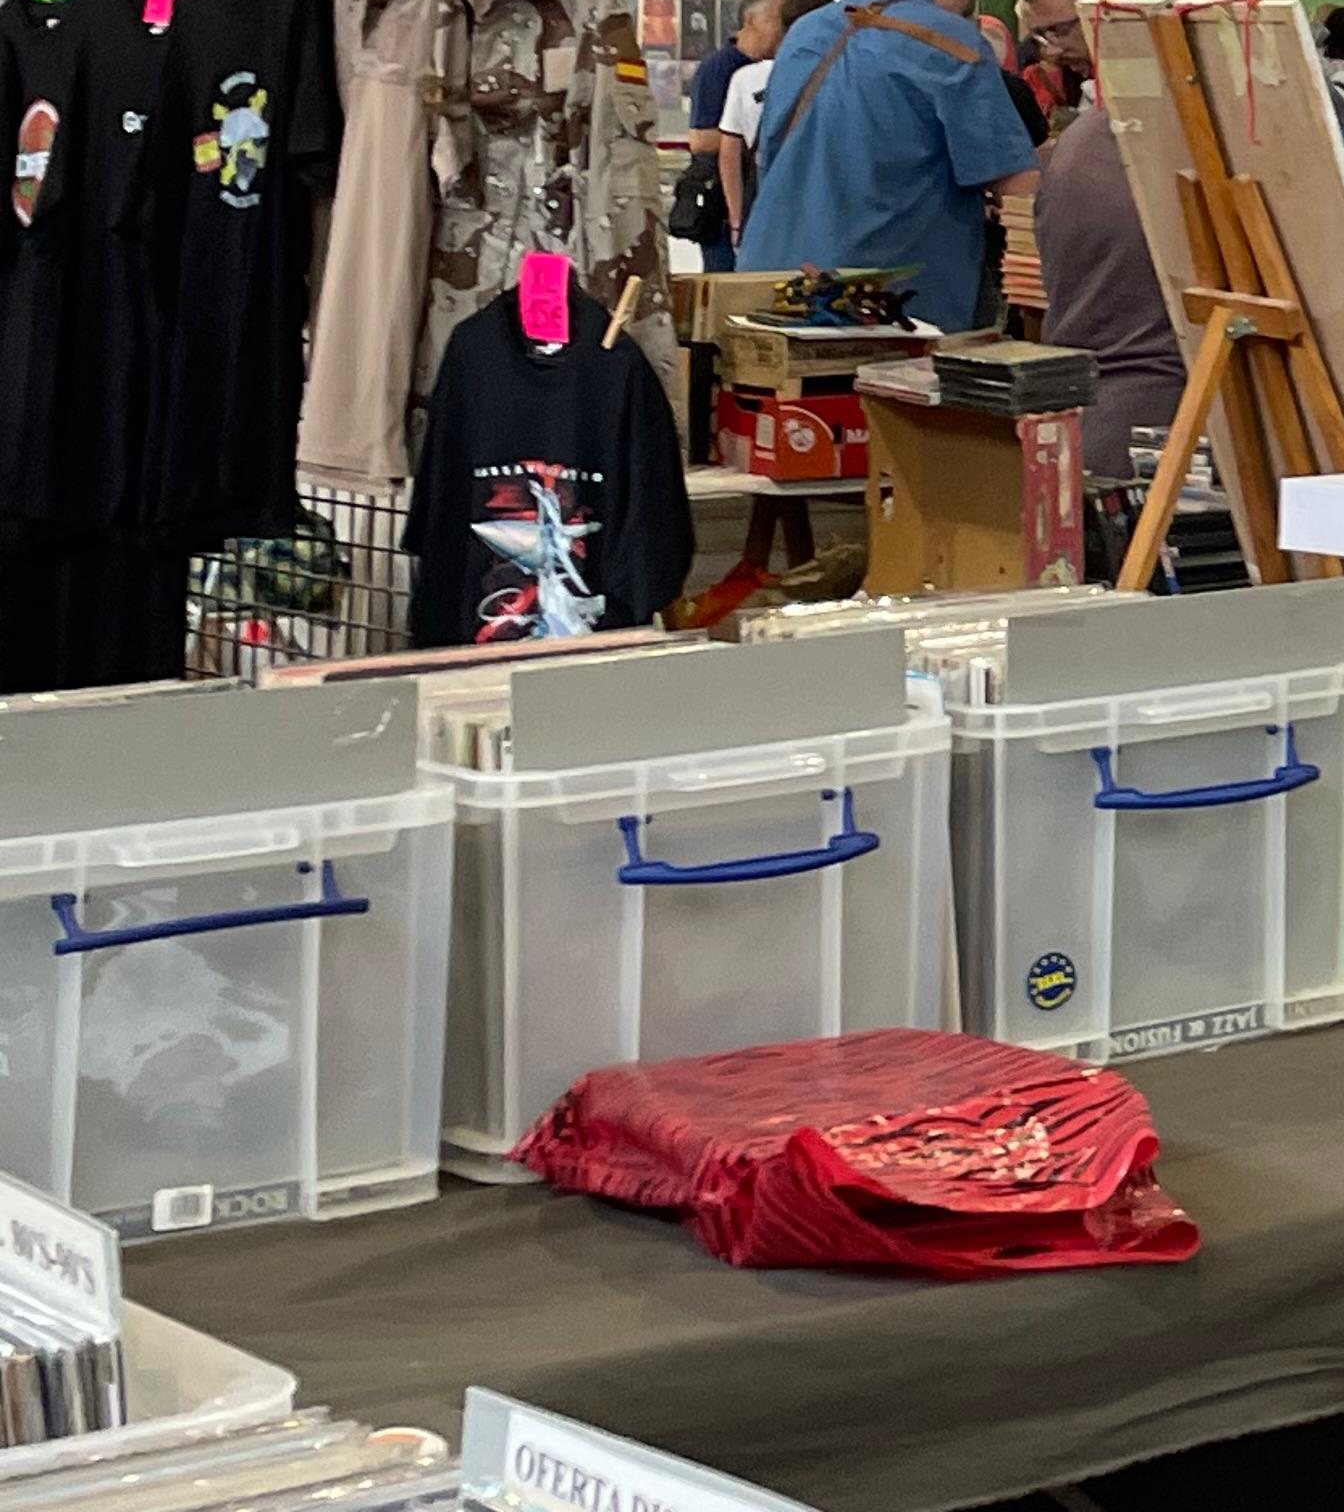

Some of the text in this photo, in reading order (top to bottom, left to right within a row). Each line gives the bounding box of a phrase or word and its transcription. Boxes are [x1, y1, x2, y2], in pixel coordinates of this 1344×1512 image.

[1212, 1007, 1258, 1035] JAZZ
[1109, 1024, 1182, 1056] FUSION
[215, 1188, 289, 1217] ROCK
[515, 1443, 622, 1512] OFERTA
